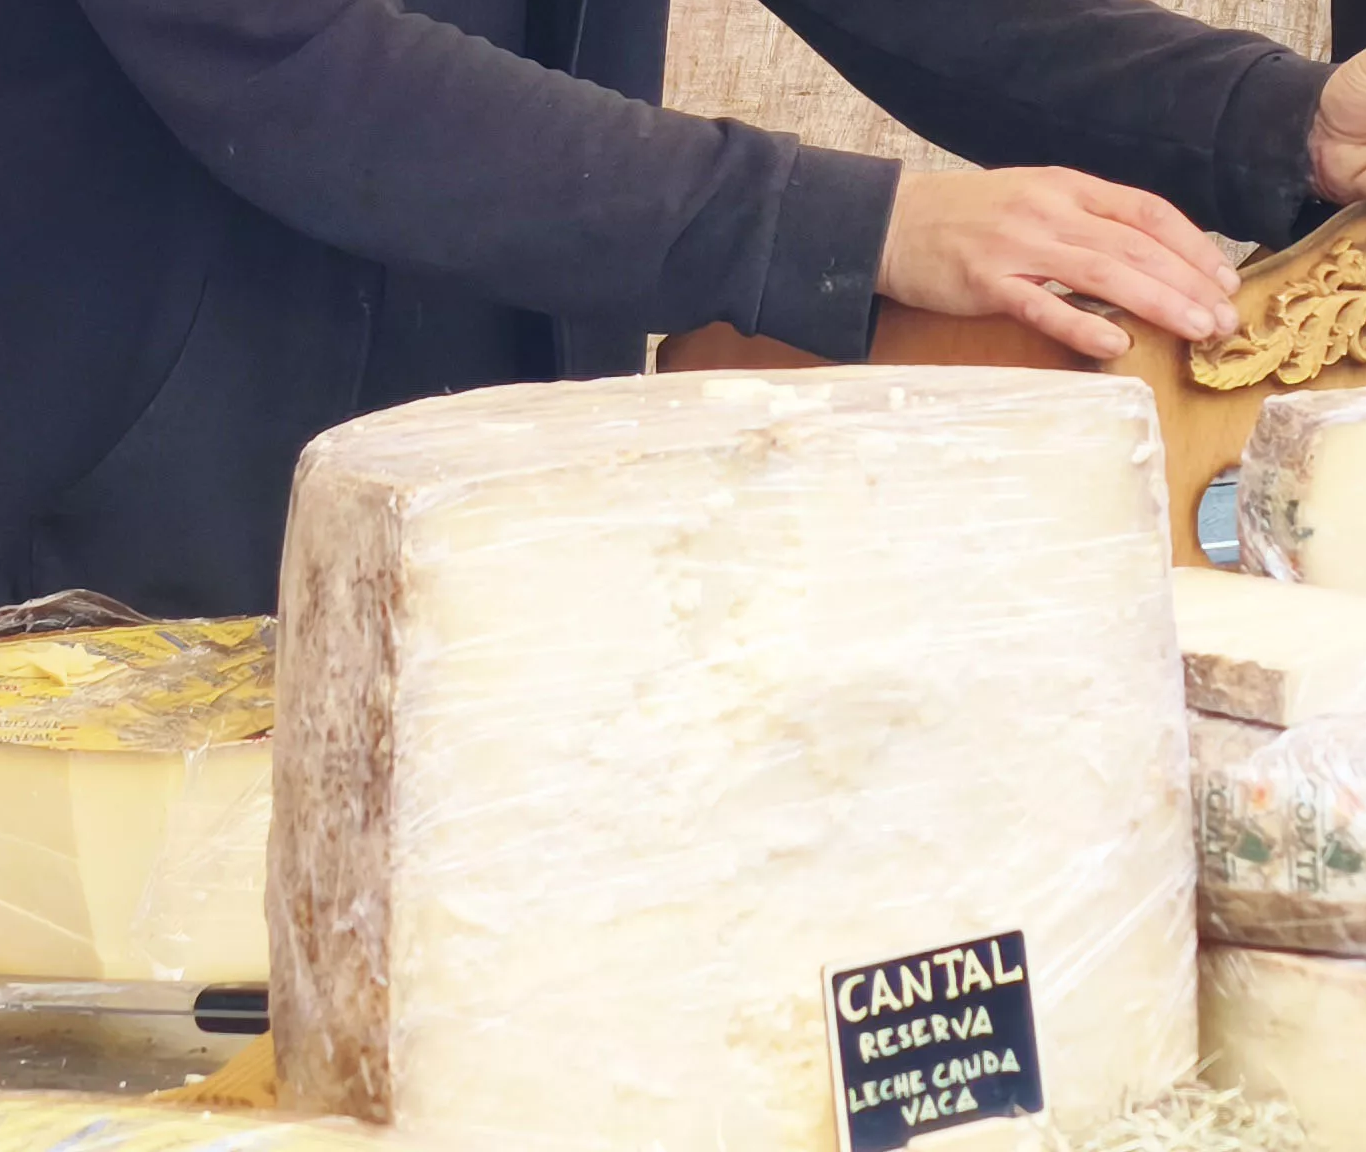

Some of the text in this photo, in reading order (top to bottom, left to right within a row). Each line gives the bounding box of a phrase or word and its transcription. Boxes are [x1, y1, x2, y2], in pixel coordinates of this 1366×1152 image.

[838, 940, 1024, 1023] CANTAL
[859, 1005, 994, 1064] RESERVA
[848, 1048, 1021, 1114] LECHE CRUDA
[901, 1086, 979, 1126] VACA
